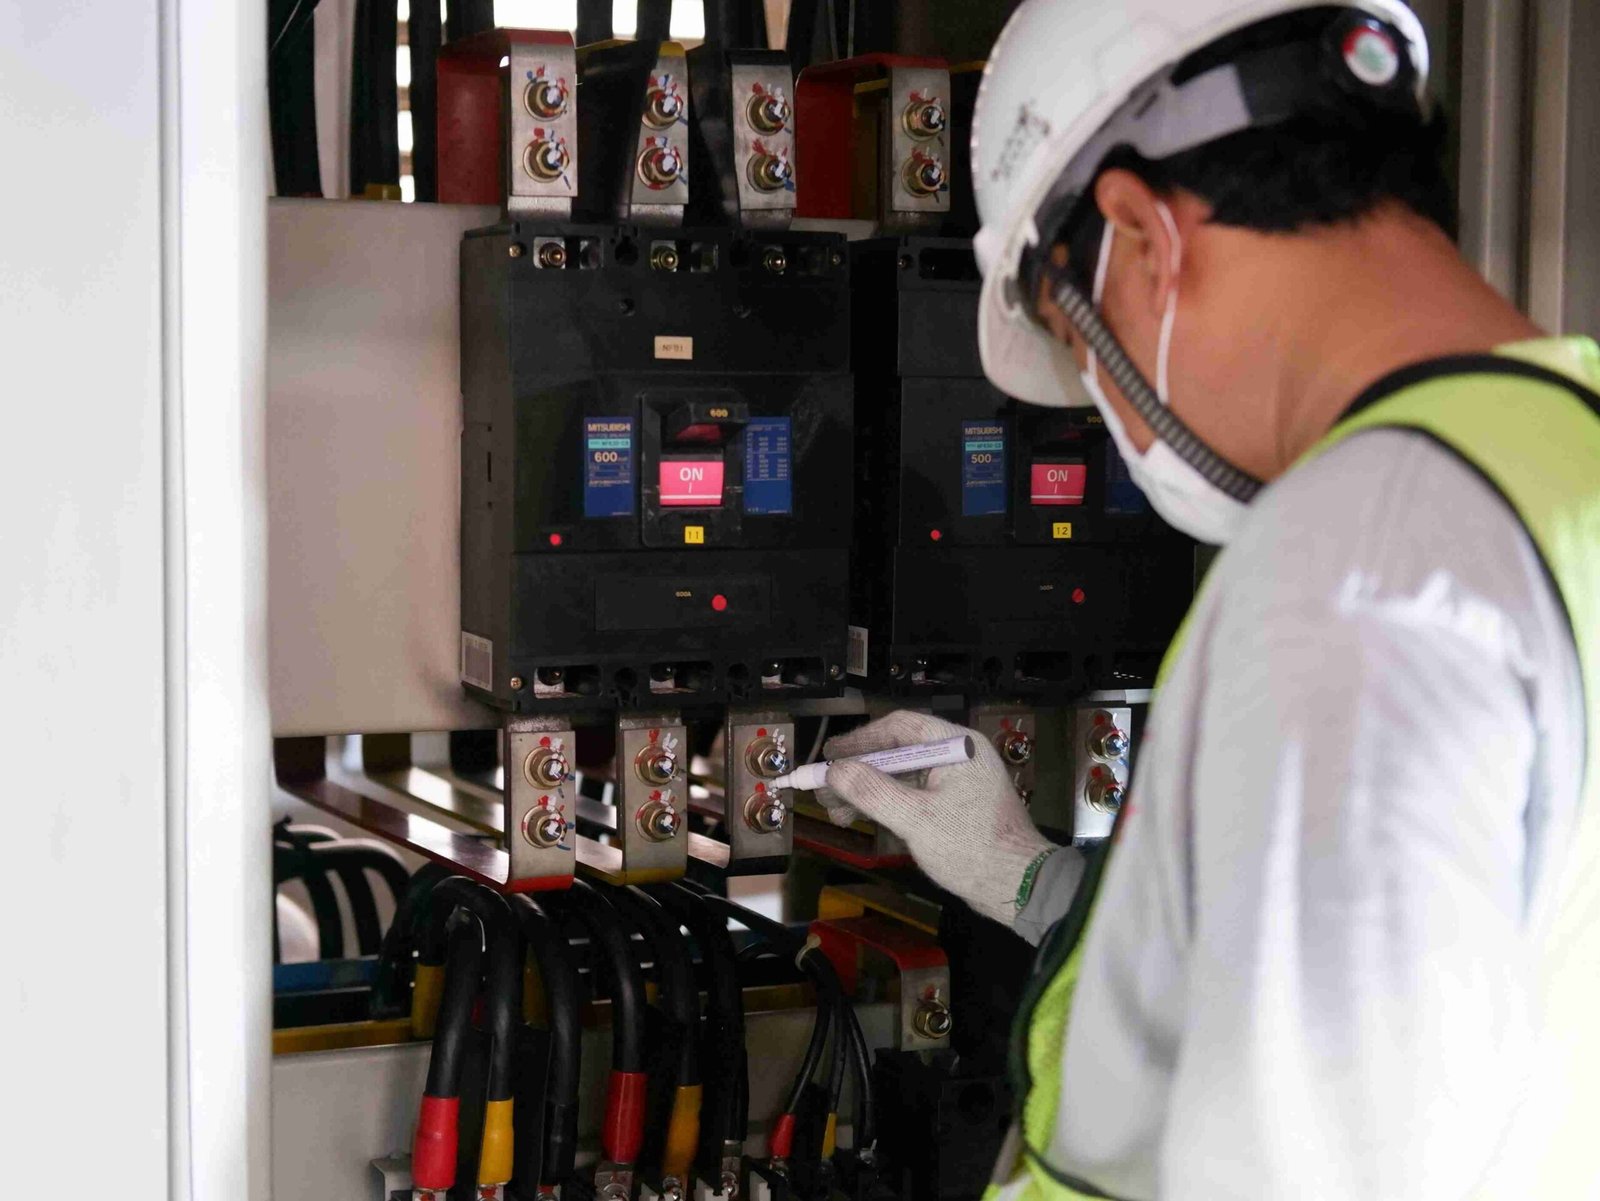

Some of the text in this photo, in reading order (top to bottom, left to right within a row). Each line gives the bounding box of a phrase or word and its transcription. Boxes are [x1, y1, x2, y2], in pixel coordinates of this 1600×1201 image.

[710, 408, 728, 418] 600
[588, 423, 631, 432] MITSUBISHI
[965, 427, 1003, 435] MITSUBISHI
[594, 451, 618, 463] 600
[971, 453, 992, 464] 500
[680, 467, 704, 482] ON
[1047, 469, 1068, 482] ON
[688, 531, 699, 540] 11
[1057, 526, 1068, 536] 12
